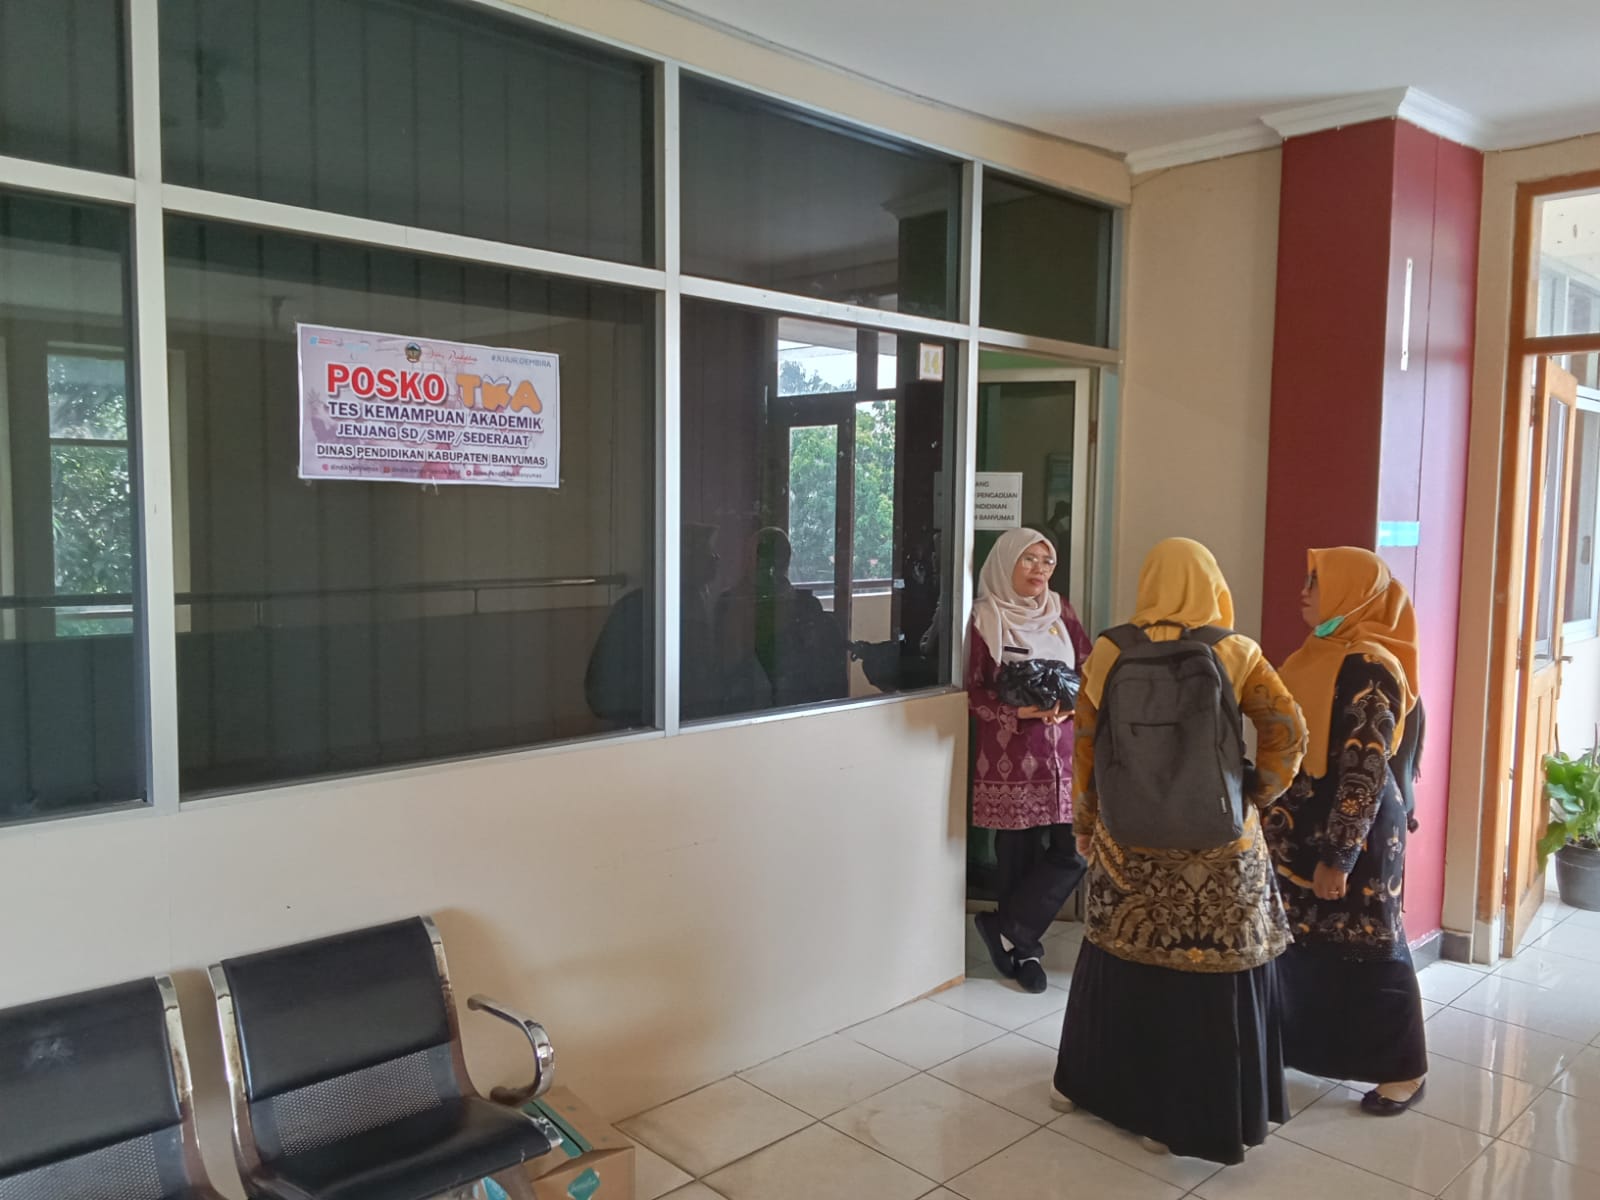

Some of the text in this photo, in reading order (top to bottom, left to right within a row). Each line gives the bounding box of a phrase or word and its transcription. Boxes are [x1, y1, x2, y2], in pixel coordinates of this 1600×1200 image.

[328, 364, 543, 414] POSKO TKA
[328, 402, 542, 430] TES KEMAMPUAN AKADEMIK
[338, 423, 529, 446] JENJANG SD/SMP/SEDERAJAT
[317, 445, 545, 465] DINAS PENDIDIKAN KABUPATEN BANYUMAS
